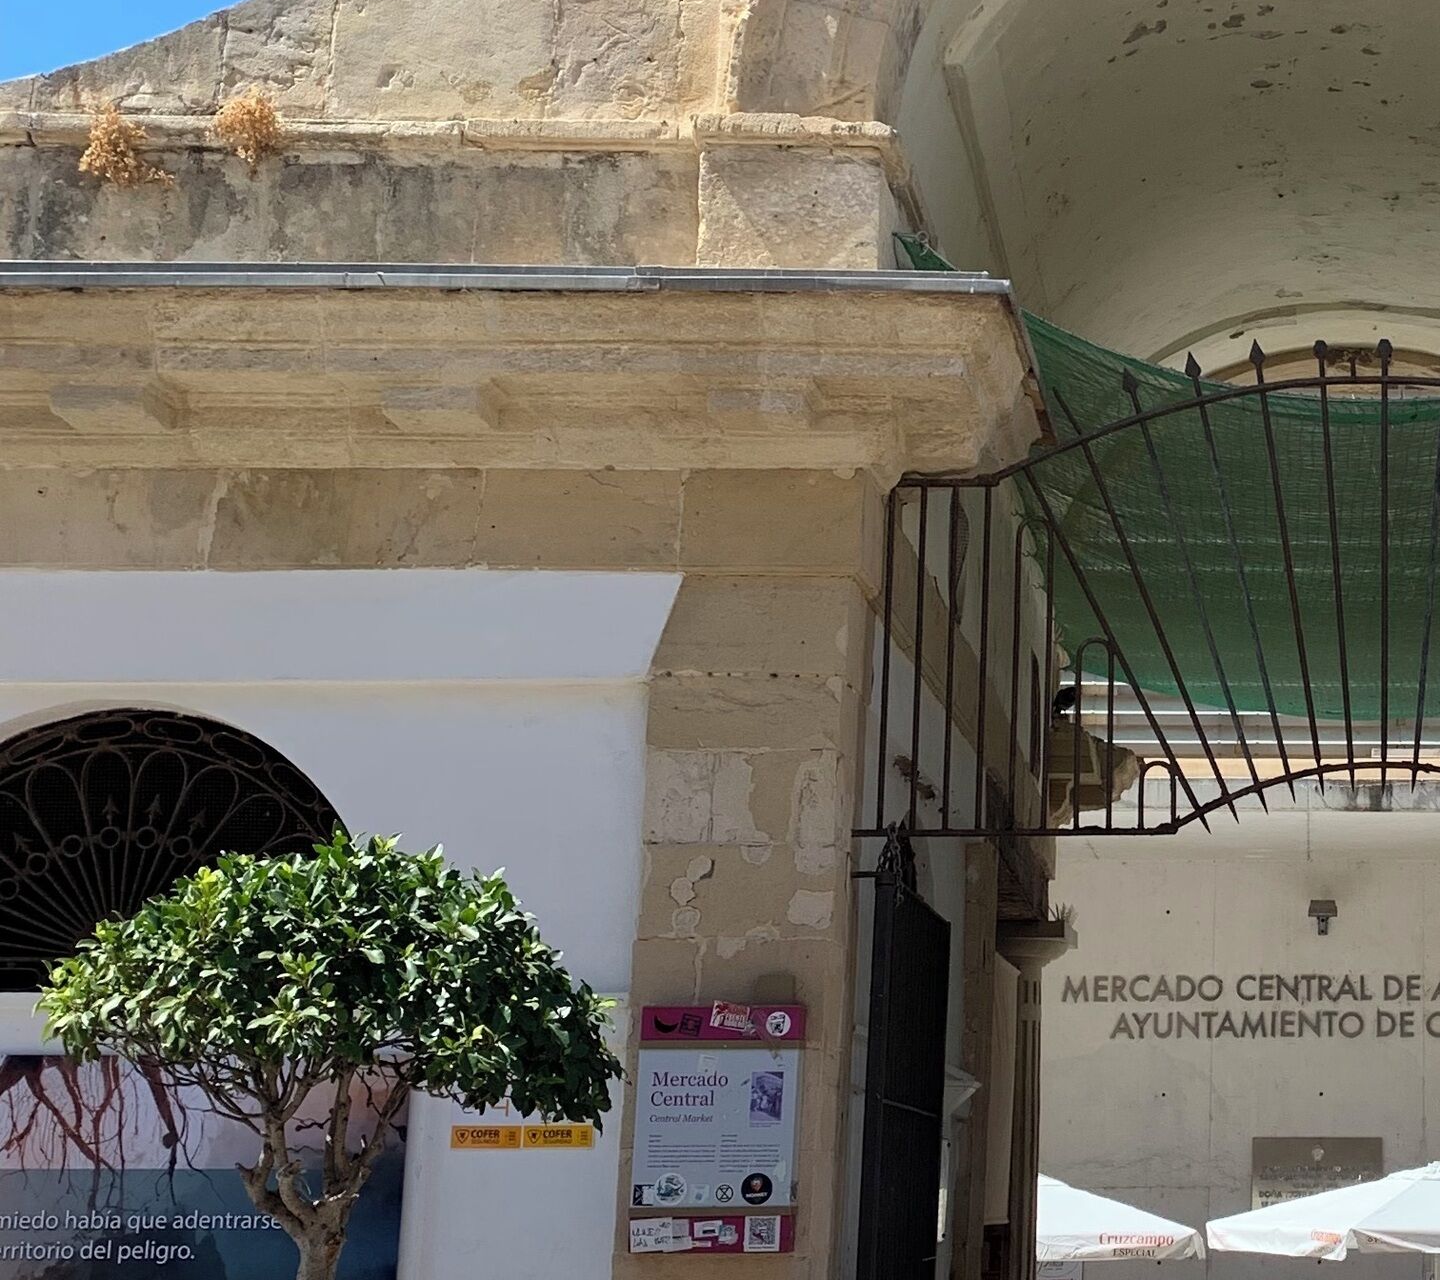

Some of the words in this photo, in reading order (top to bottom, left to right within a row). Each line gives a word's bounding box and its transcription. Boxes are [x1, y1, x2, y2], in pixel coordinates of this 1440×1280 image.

[1062, 975, 1222, 1002] MERCADO
[1236, 974, 1372, 1003] CENTRAL
[1383, 974, 1421, 1002] DE
[1110, 1010, 1364, 1039] AYUNTAMIENTO
[1376, 1009, 1414, 1038] DE
[652, 1070, 729, 1088] Mercado
[650, 1090, 715, 1107] Central
[471, 1129, 500, 1139] COFER
[543, 1129, 572, 1139] COFER
[65, 1210, 121, 1230] había
[128, 1215, 167, 1234] que
[173, 1210, 282, 1230] adentrarse
[1099, 1232, 1175, 1247] Cruzcampo
[0, 1240, 74, 1260] rritorio
[80, 1240, 112, 1260] del
[117, 1240, 196, 1265] peligro.
[1113, 1248, 1157, 1257] ESPECIAL
